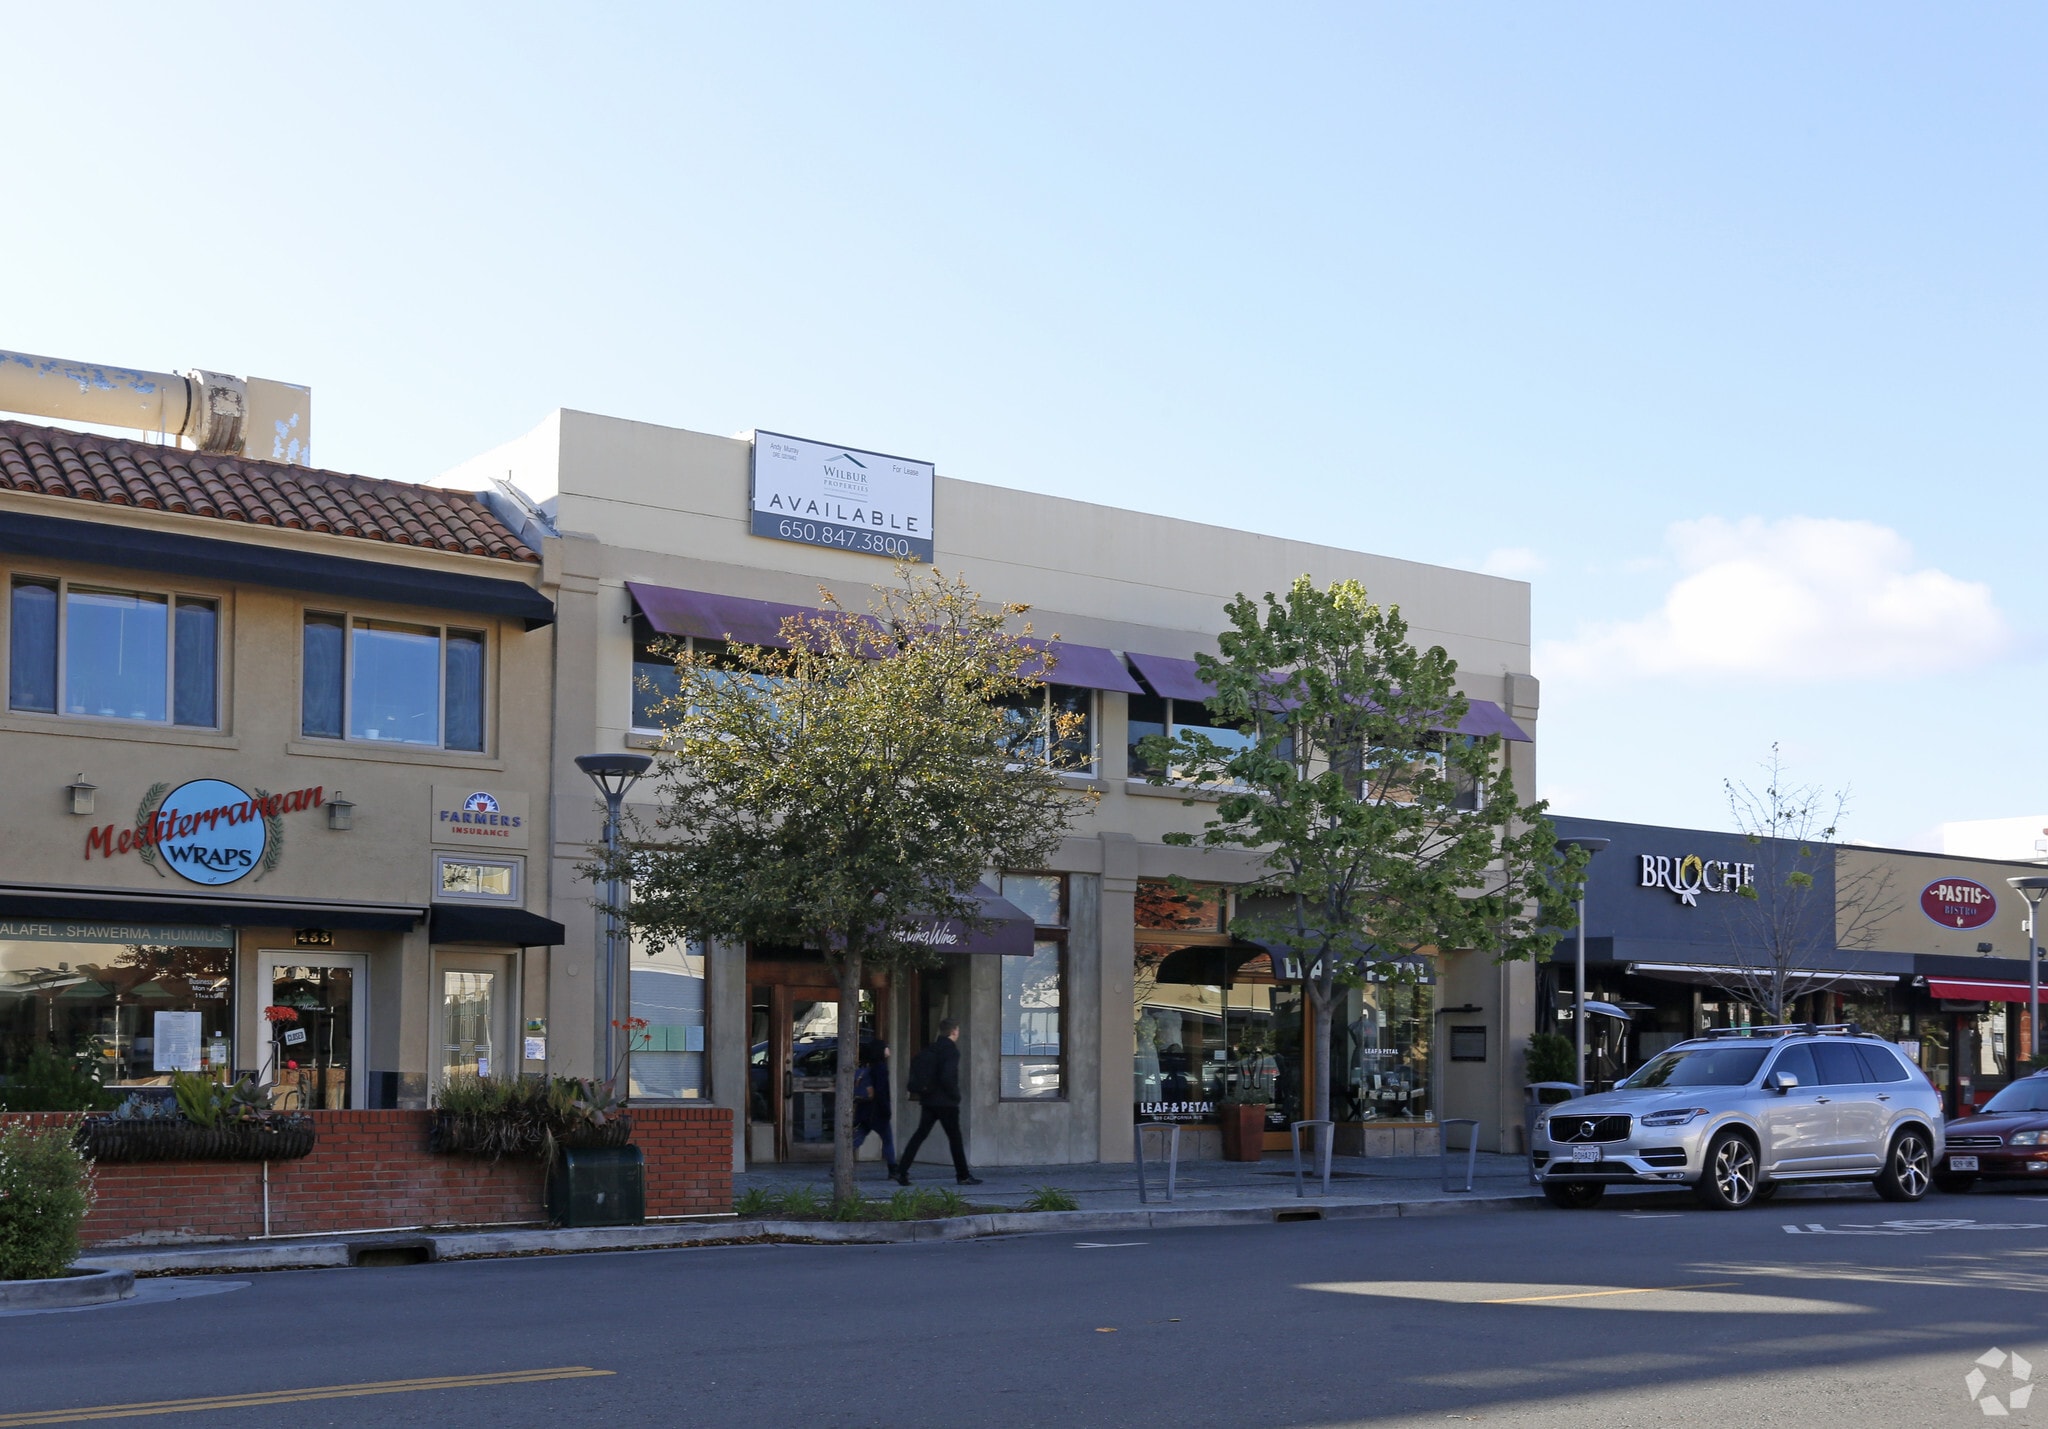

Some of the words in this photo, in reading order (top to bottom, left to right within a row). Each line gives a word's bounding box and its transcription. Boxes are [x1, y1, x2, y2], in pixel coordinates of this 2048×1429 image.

[823, 464, 868, 484] WILBUR
[892, 464, 902, 473] For
[903, 466, 919, 477] Lease
[823, 479, 869, 493] PROPERTIES
[769, 493, 918, 532] AVAILABLE
[779, 519, 909, 556] 650.847.3800
[84, 785, 326, 861] Mediterranean
[440, 811, 522, 828] FARMERS
[452, 826, 510, 838] INSURANCE
[168, 843, 252, 871] WRAPS
[1641, 854, 1755, 902] BRIOCHE
[1938, 884, 1982, 904] PASTIS
[1944, 905, 1977, 916] BISTRO
[66, 925, 151, 940] SHAWERMA
[160, 929, 224, 942] HUMMUS
[298, 932, 330, 943] 433
[929, 921, 958, 945] Wine
[1140, 1101, 1169, 1114] LEAF
[1171, 1101, 1180, 1113] &
